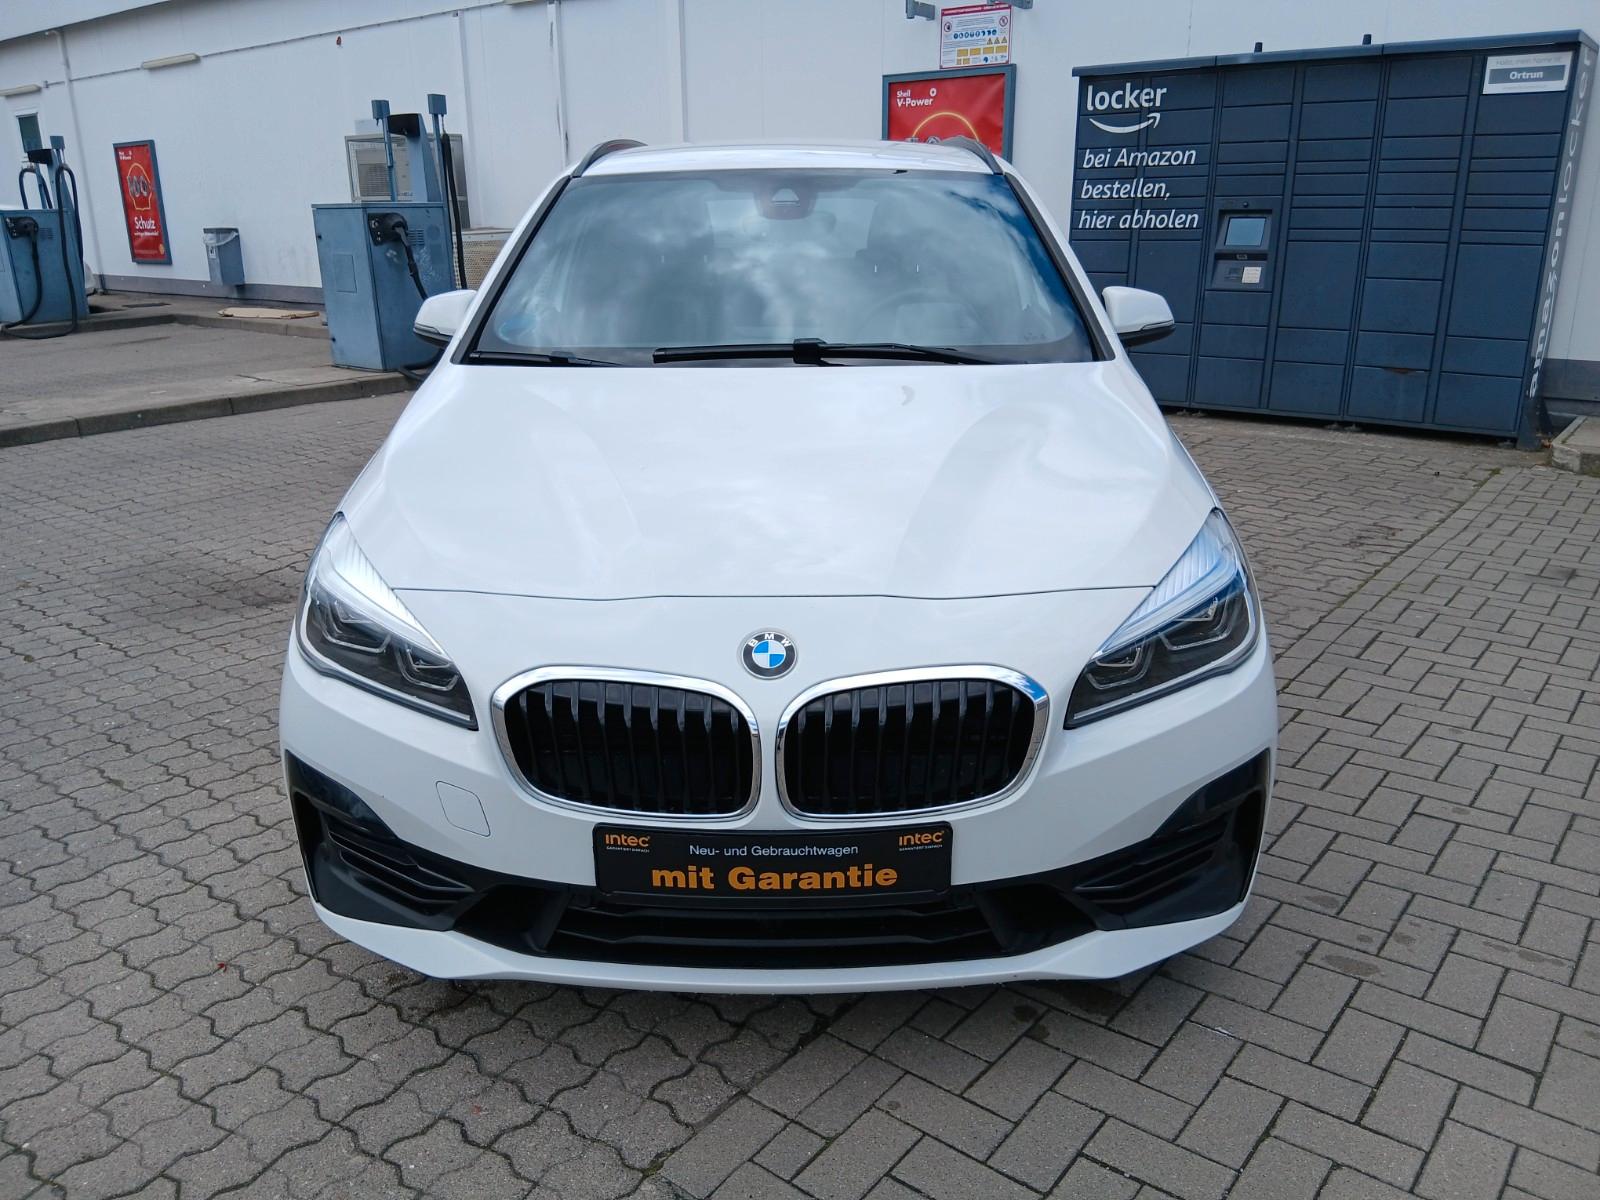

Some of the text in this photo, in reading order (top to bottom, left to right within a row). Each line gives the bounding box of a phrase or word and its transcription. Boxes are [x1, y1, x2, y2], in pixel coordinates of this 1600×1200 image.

[1509, 71, 1544, 80] Ortrun
[897, 88, 911, 98] Shell
[1086, 82, 1168, 111] locker
[897, 97, 934, 107] V-Power
[1082, 148, 1197, 168] bei Amazon
[1080, 178, 1171, 201] bestellen,
[1078, 208, 1199, 229] hier abholen
[747, 633, 792, 647] BMW
[689, 844, 859, 859] Neu- und Gebrauchtwagen
[651, 863, 899, 890] mit Garantie
